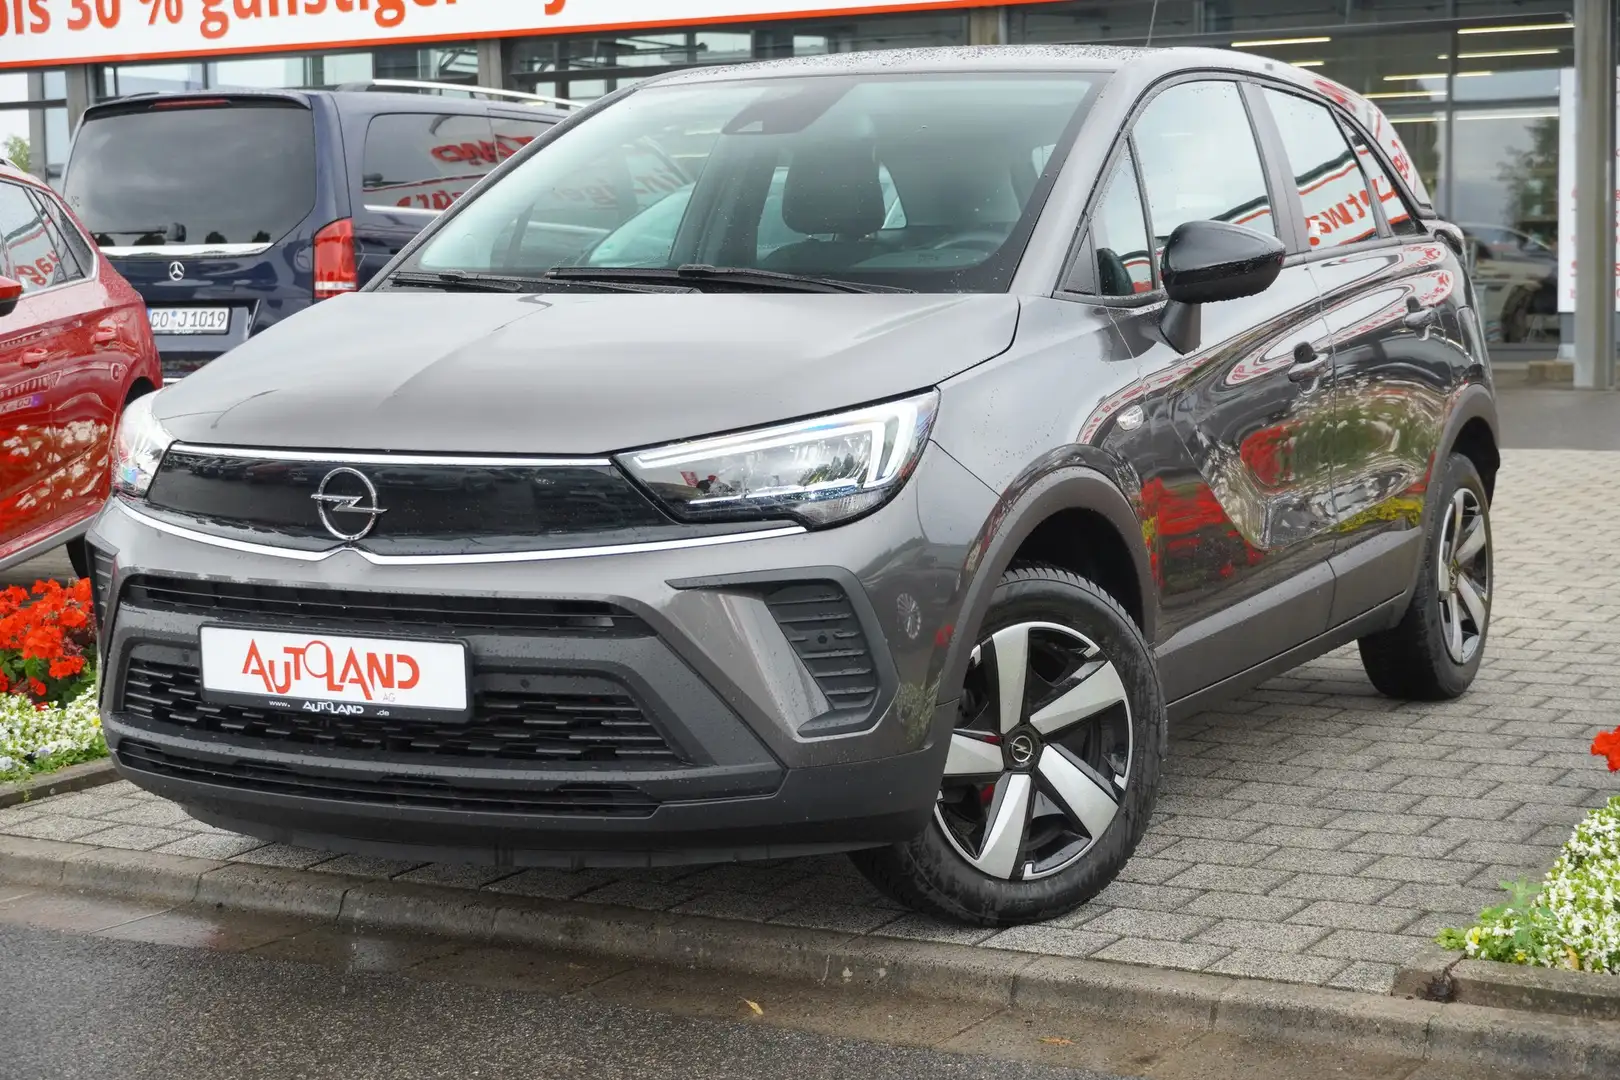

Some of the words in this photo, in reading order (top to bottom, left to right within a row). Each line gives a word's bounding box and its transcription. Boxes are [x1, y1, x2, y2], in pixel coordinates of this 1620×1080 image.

[151, 311, 169, 327] CO
[242, 638, 420, 700] AUTOLAND
[302, 701, 364, 716] AUTOLAND
